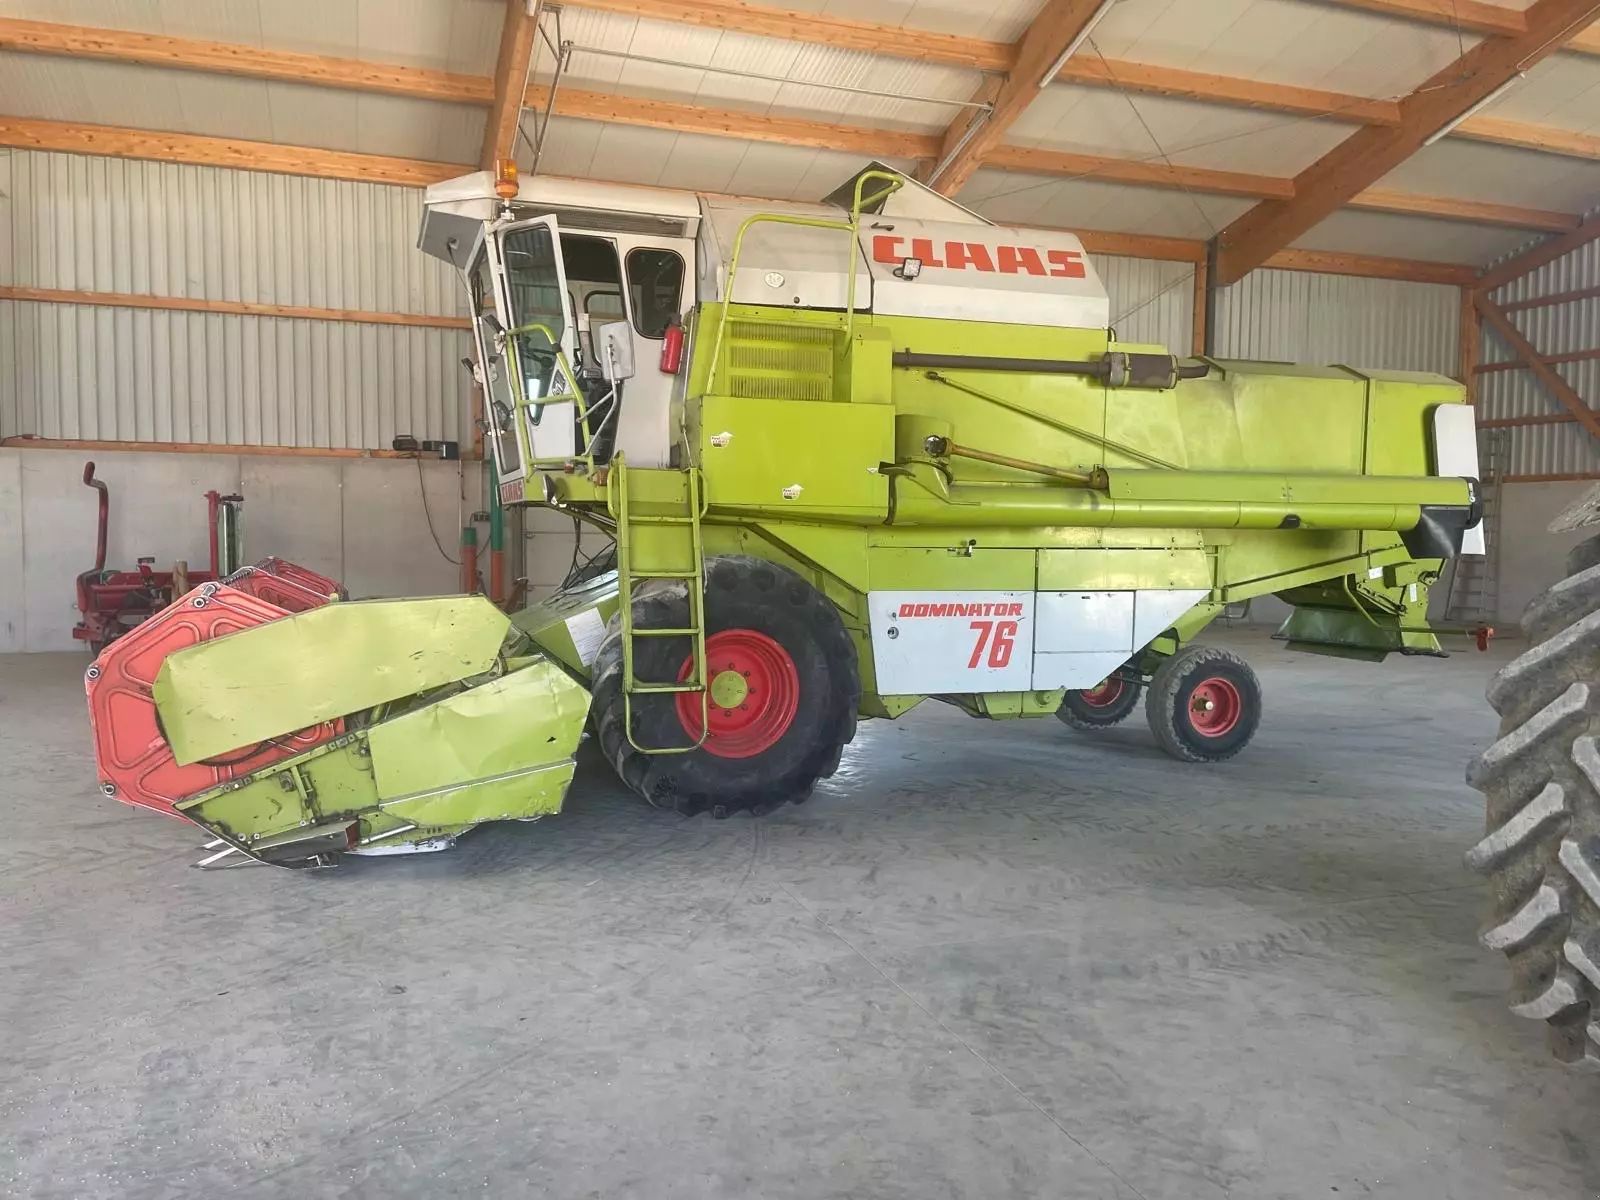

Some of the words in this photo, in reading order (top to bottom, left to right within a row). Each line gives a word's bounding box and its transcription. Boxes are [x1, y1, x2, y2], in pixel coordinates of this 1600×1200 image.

[873, 235, 1086, 278] CLAAS
[899, 603, 1023, 617] DOMINATOR
[968, 621, 1018, 668] 76
